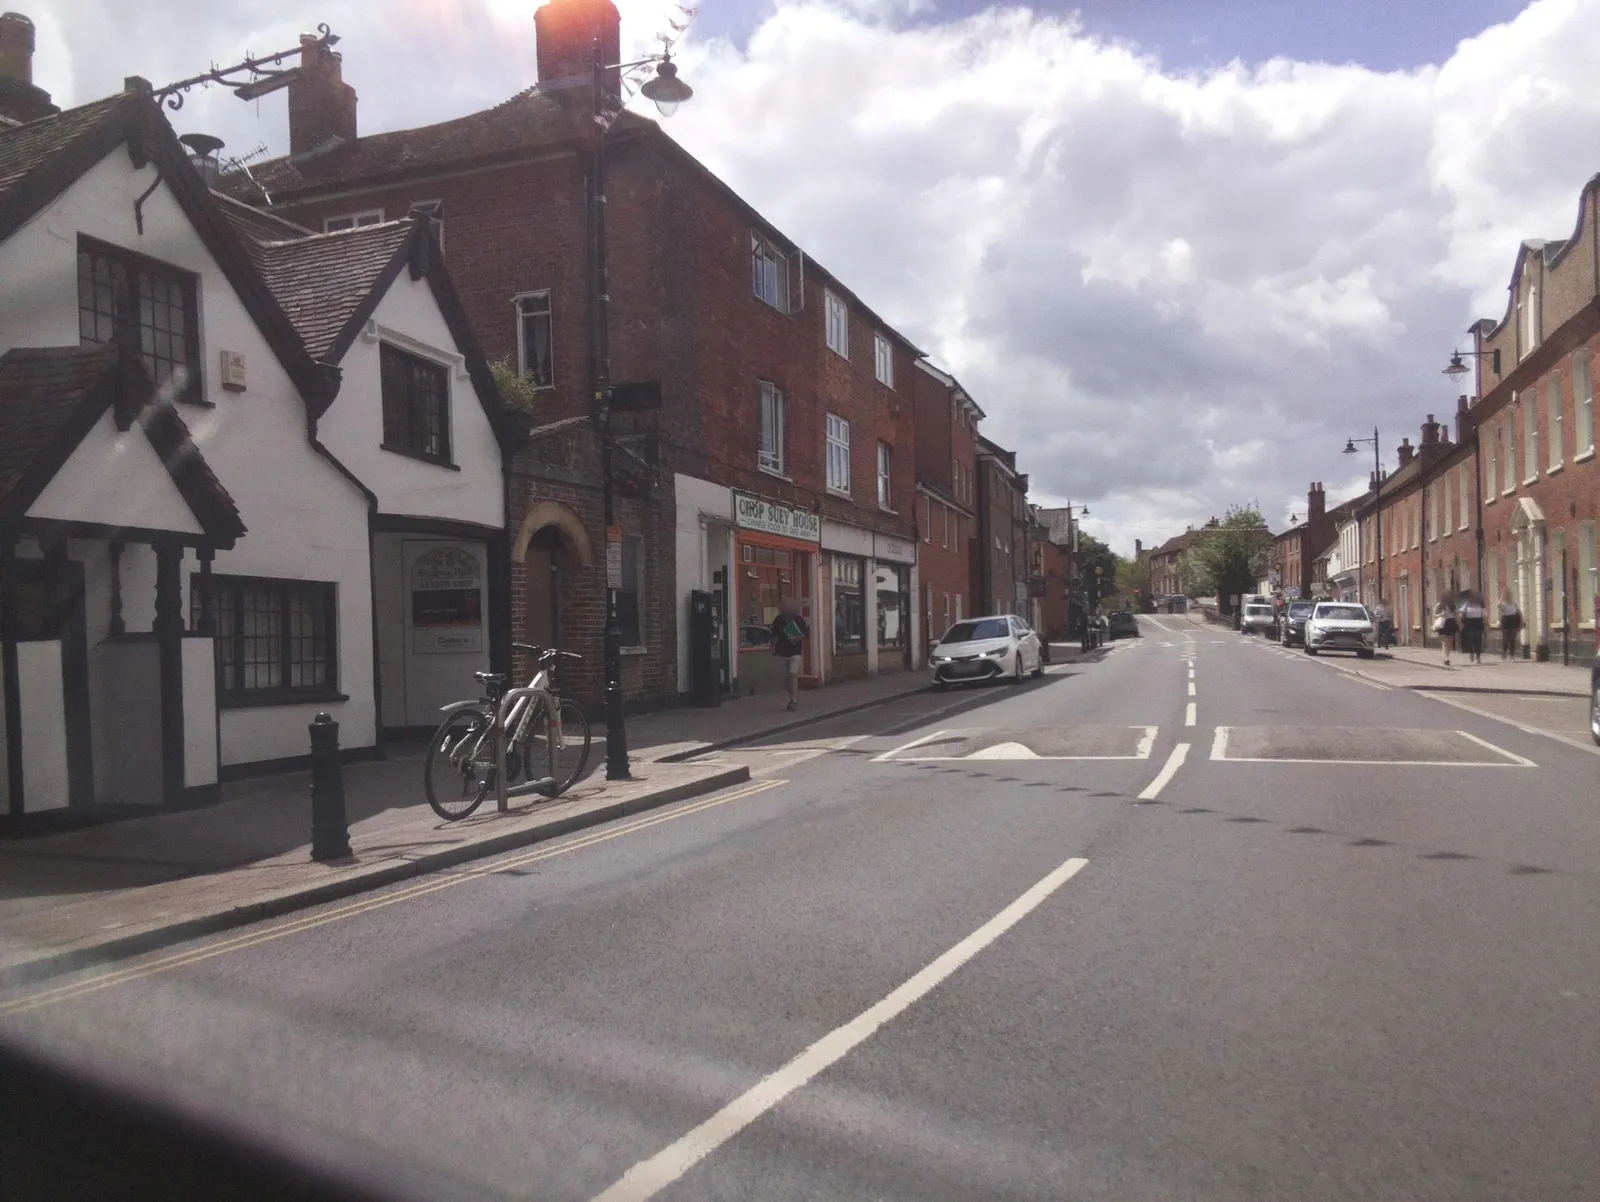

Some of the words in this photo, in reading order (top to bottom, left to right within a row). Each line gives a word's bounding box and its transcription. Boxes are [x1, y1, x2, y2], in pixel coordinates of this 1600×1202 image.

[738, 499, 765, 520] CHOP
[768, 506, 790, 526] SUEY
[792, 512, 818, 533] HOUSE
[767, 522, 781, 532] FOOD
